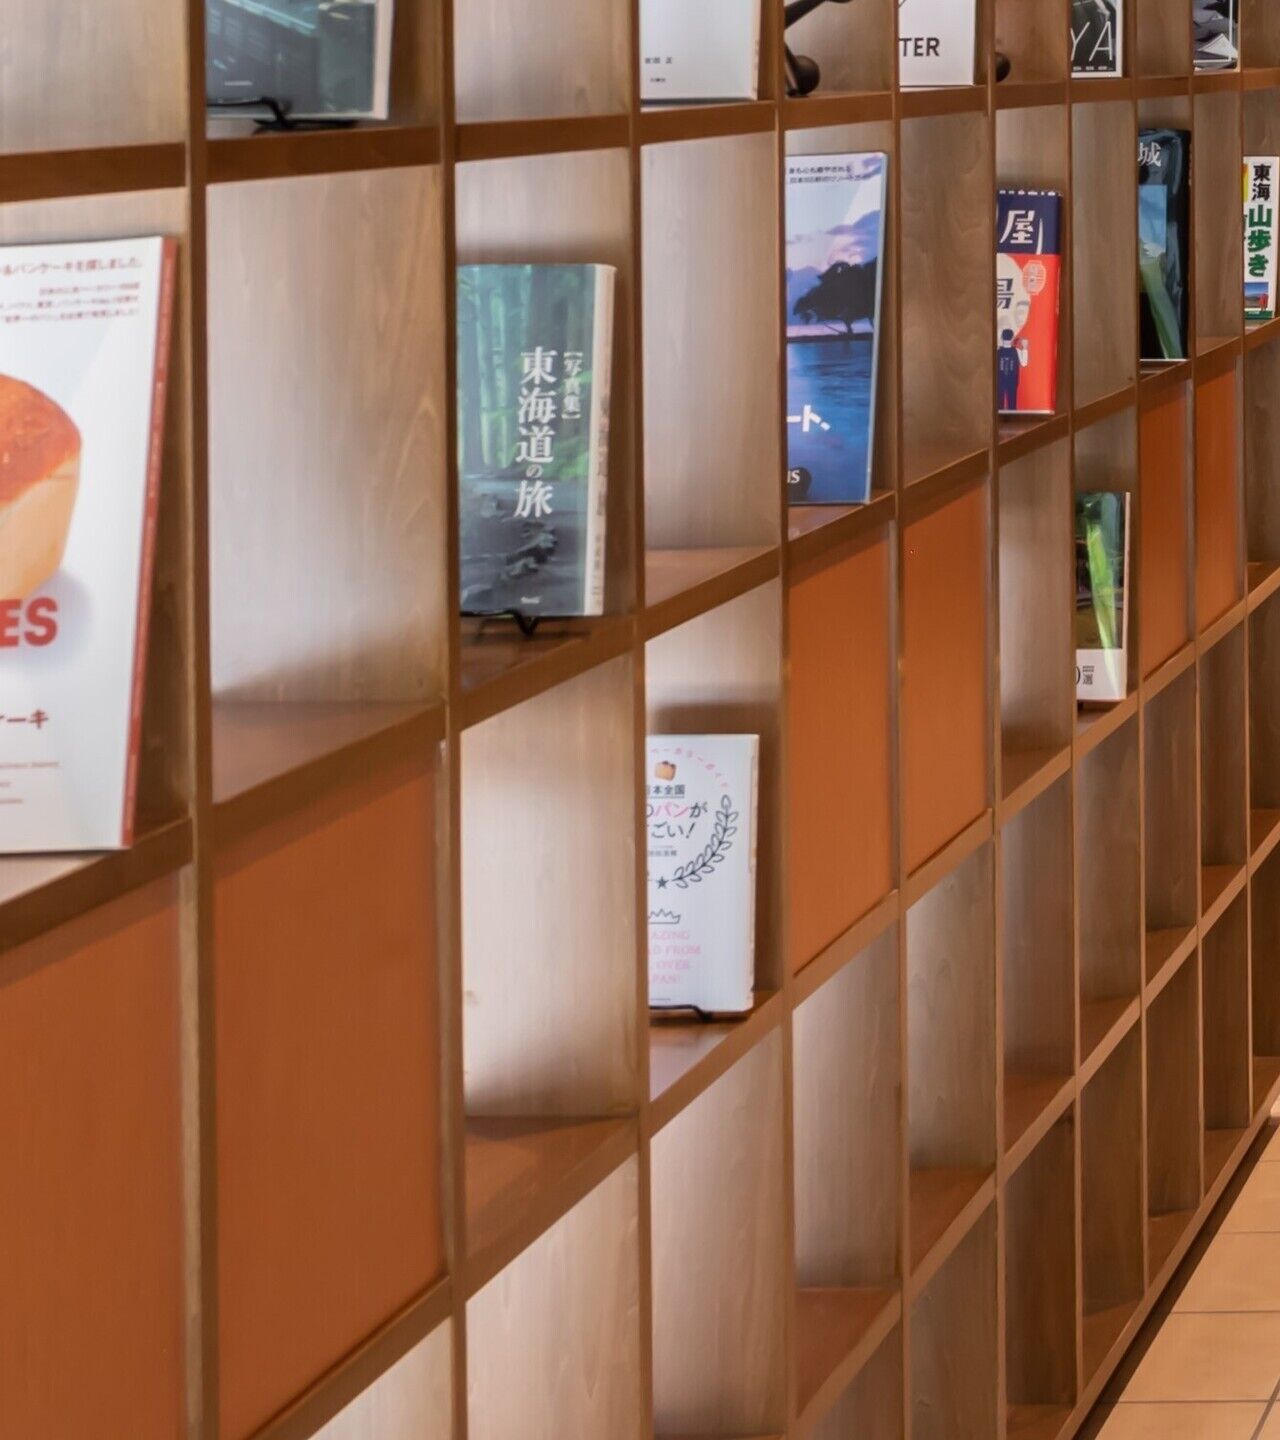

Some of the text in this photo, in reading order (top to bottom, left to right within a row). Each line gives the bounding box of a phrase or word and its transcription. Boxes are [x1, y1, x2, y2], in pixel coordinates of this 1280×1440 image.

[899, 37, 941, 57] TER
[999, 209, 1036, 244] 屋
[513, 346, 558, 518] 東海道の旅
[0, 710, 48, 729] ーキ
[647, 821, 696, 840] ごい!
